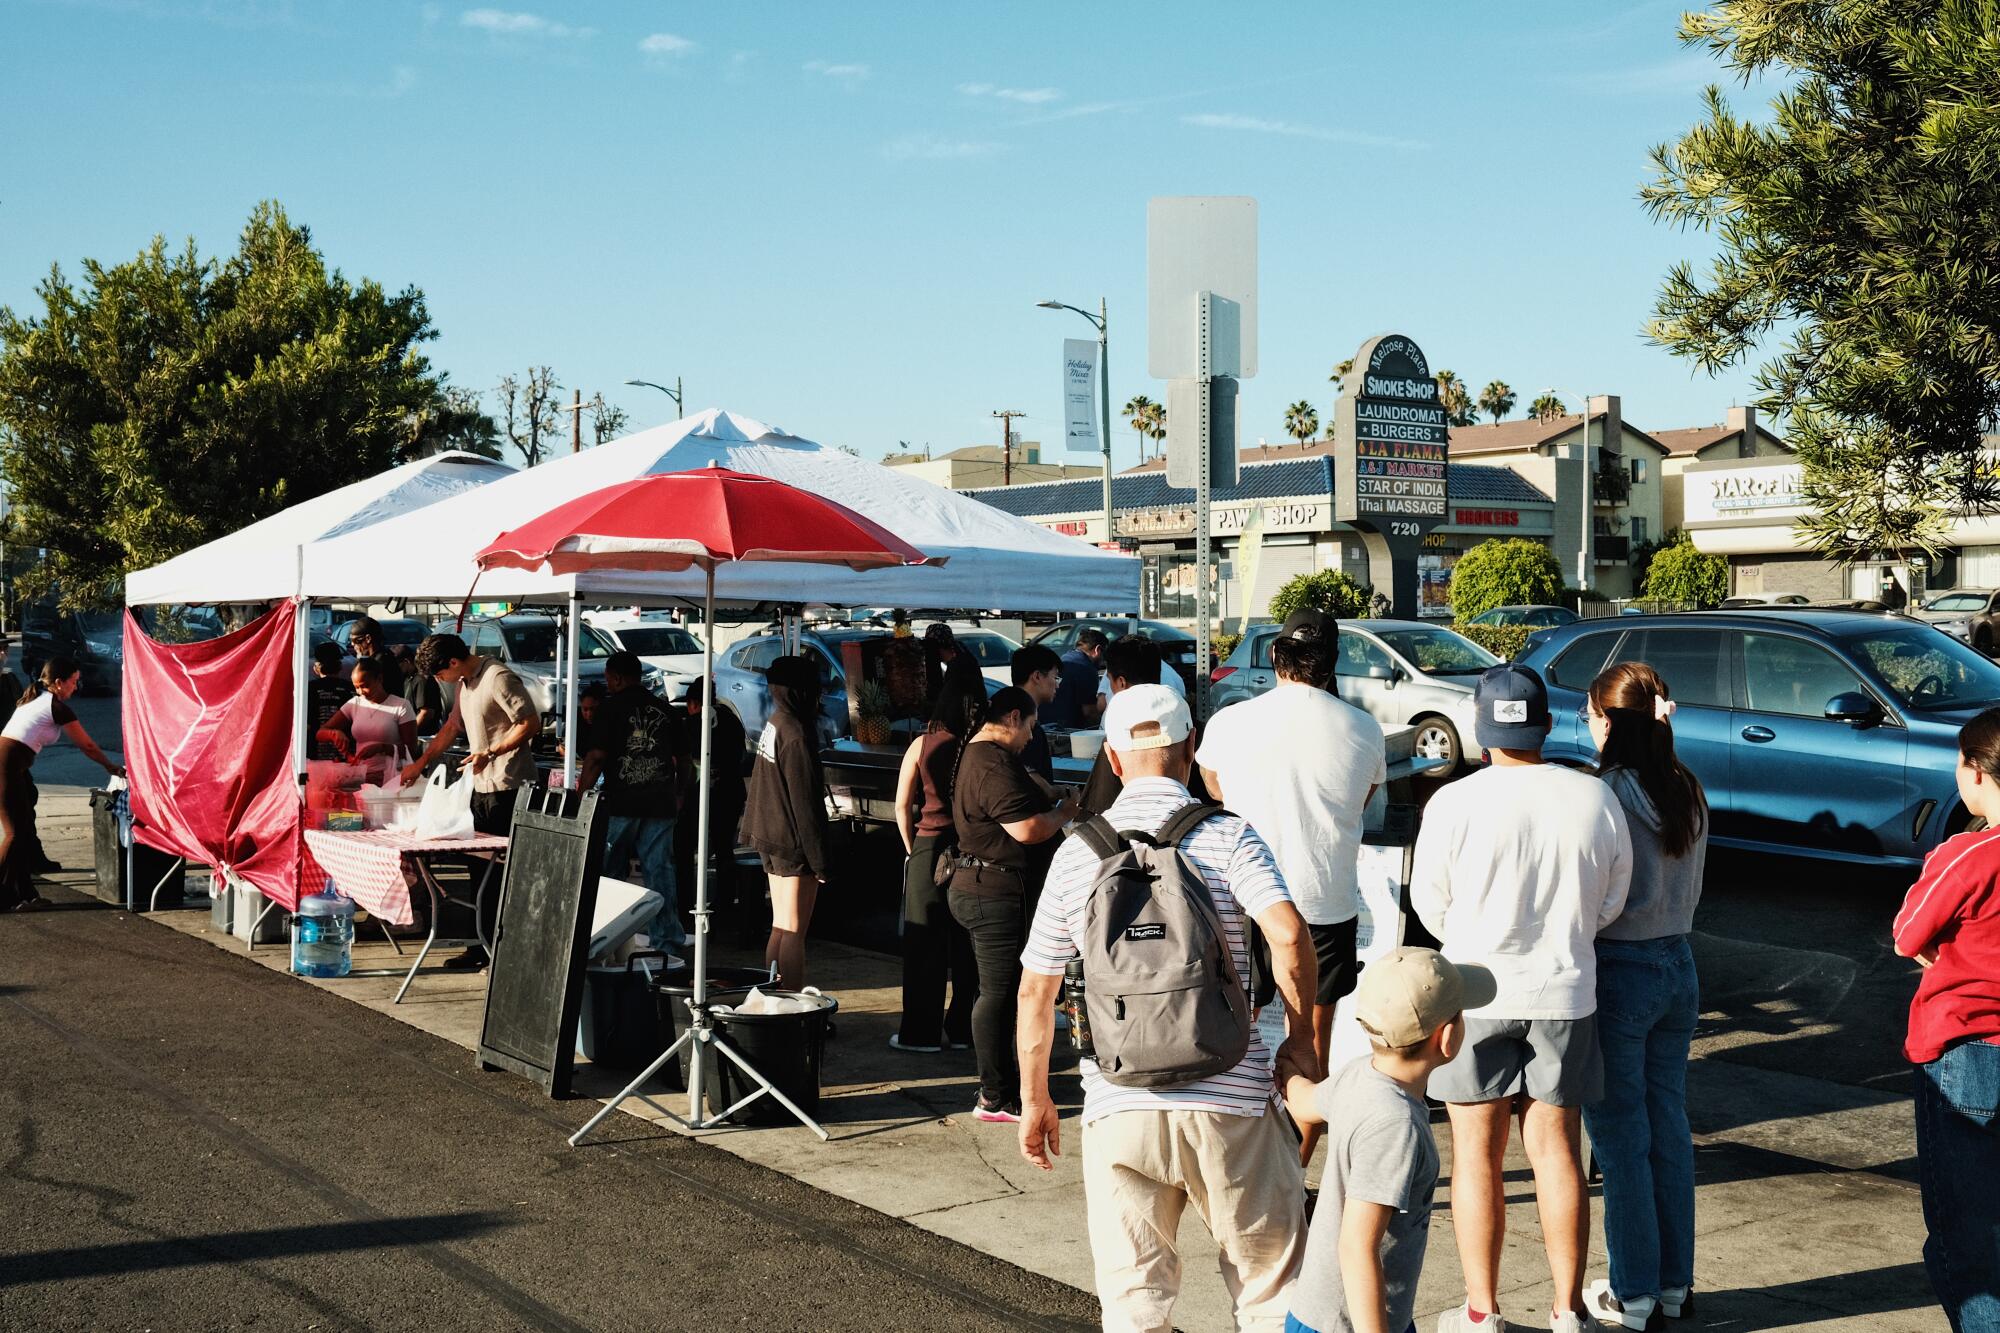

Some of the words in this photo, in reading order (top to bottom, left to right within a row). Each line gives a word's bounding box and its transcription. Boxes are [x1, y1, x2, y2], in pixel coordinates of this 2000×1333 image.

[1371, 341, 1404, 370] Melrose
[1405, 343, 1426, 374] Place
[1367, 376, 1405, 397] SMOKE
[1405, 379, 1435, 399] SHOP
[1357, 403, 1444, 423] LAUNDROMAT
[1371, 424, 1431, 440] BURGERS
[1368, 441, 1388, 456] LA
[1393, 442, 1444, 460] FLAMA
[1359, 460, 1384, 474] A&J
[1386, 462, 1444, 478] MARKET
[1358, 480, 1391, 493] STAR
[1393, 481, 1410, 494] OF
[1413, 483, 1444, 496] INDIA
[1359, 498, 1383, 512] Thai
[1387, 500, 1445, 514] MASSAGE
[1217, 507, 1253, 528] PAW
[1272, 504, 1317, 525] SHOP
[1456, 510, 1520, 527] BROKERS
[1391, 522, 1420, 536] 720
[1423, 533, 1447, 547] HOP
